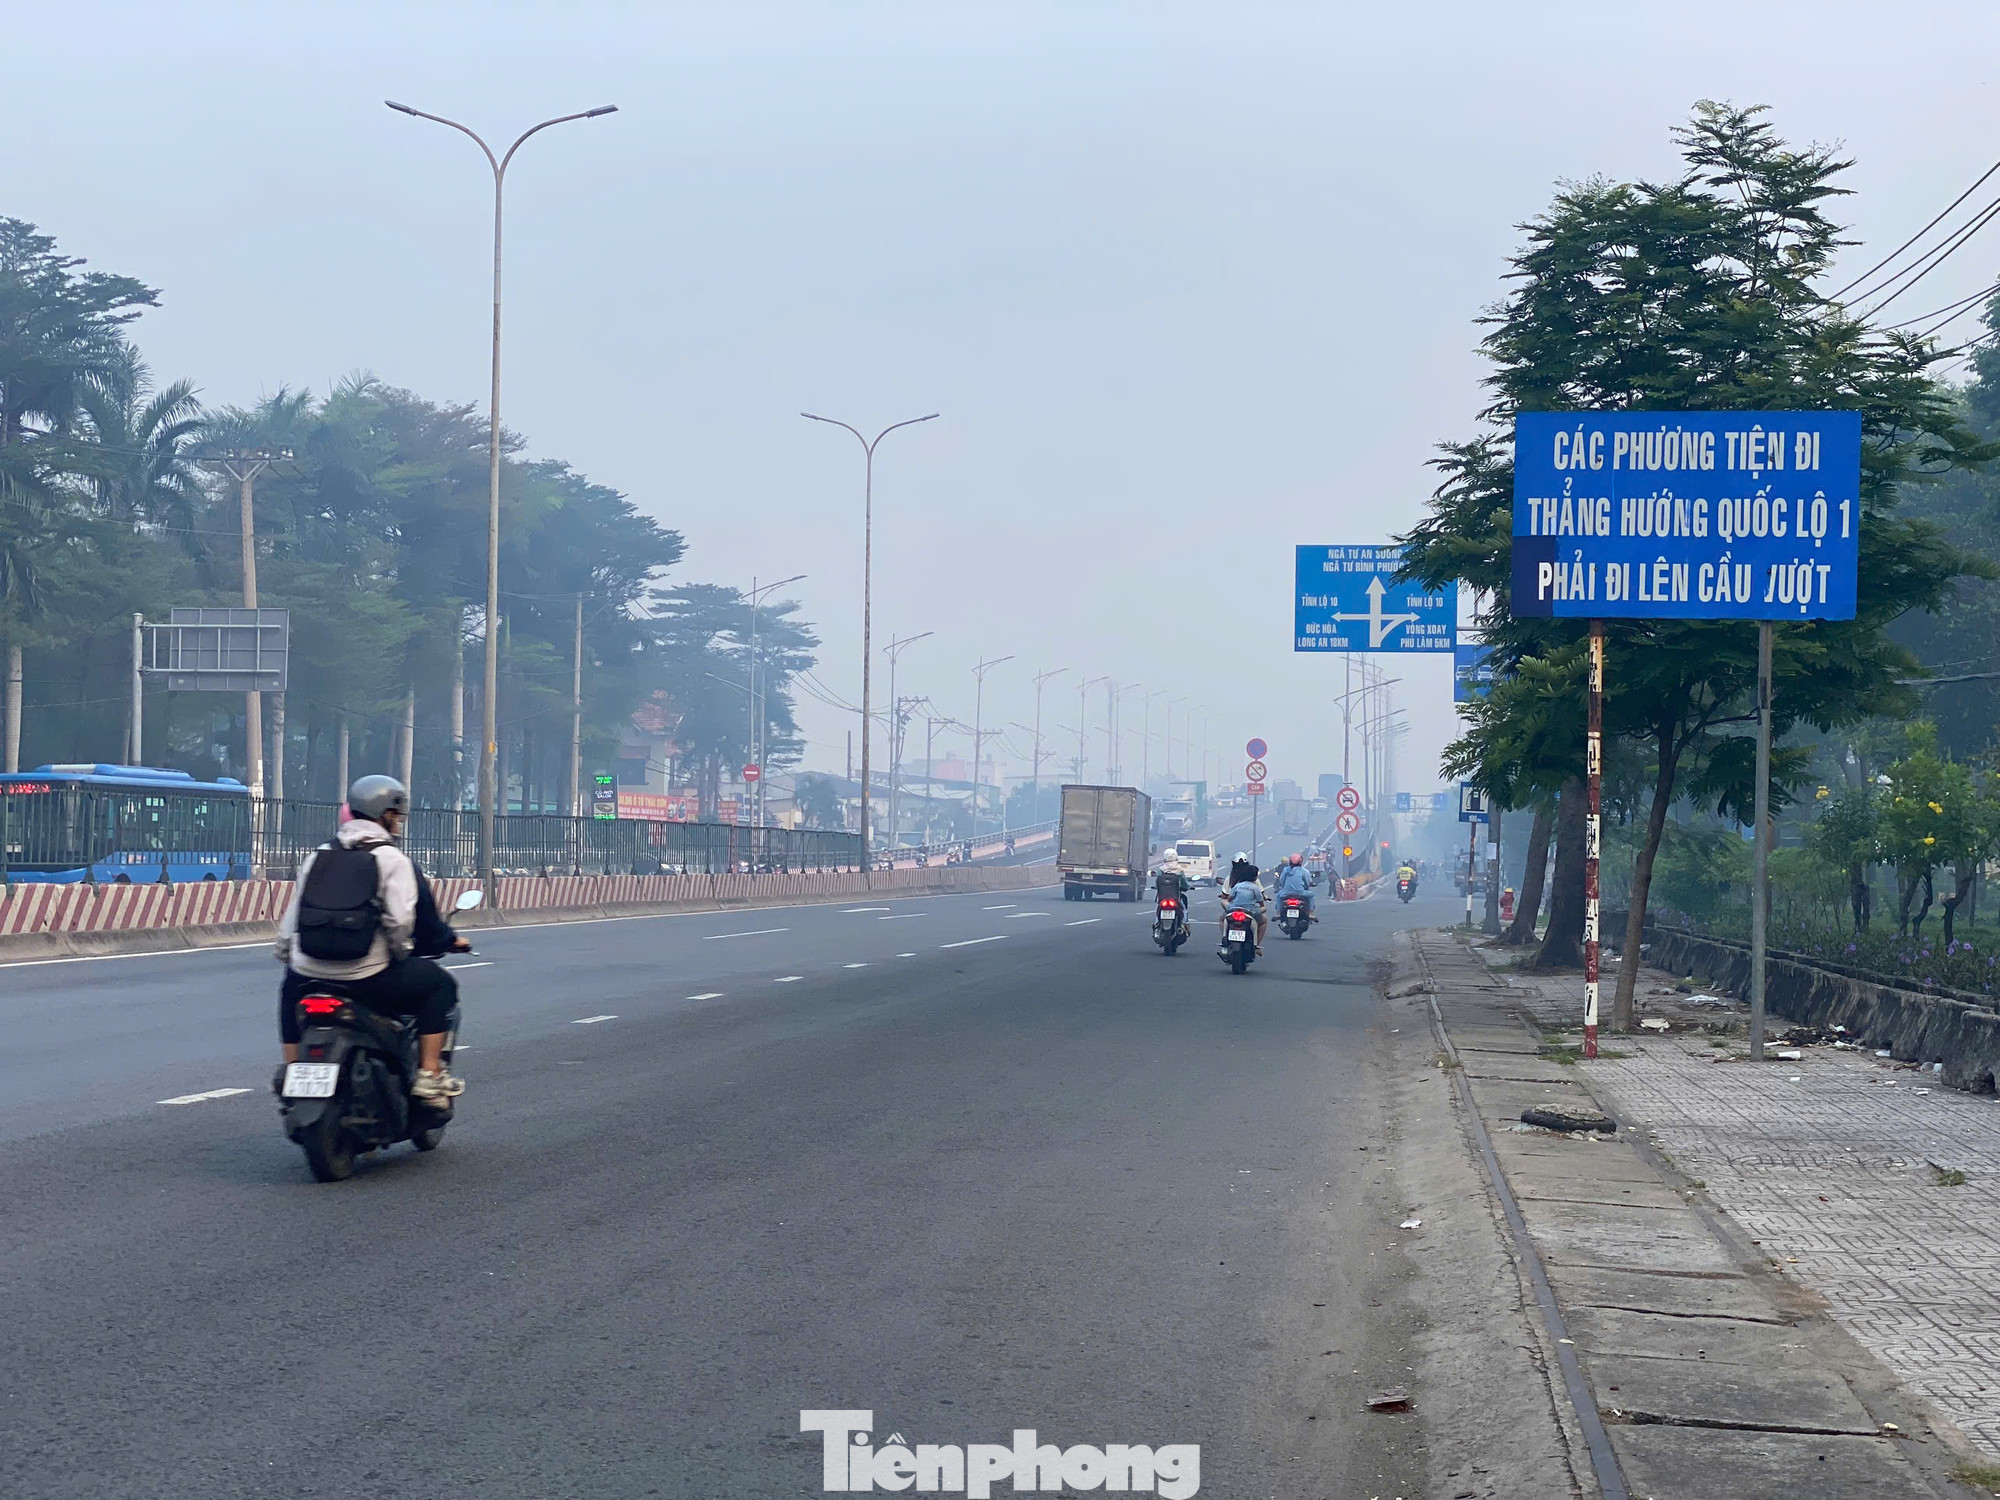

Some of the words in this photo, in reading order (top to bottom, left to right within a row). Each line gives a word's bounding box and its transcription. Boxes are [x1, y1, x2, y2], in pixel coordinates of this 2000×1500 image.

[1553, 423, 1605, 470] CÁC
[1613, 425, 1716, 471] PHƯƠNG
[1724, 424, 1785, 480] TIỆN
[1794, 431, 1820, 470] ĐI
[1527, 476, 1611, 537] THẲNG
[1620, 488, 1708, 538] HƯỚNG
[1717, 484, 1788, 544] QUỐC
[1796, 490, 1828, 548] LỘ
[1839, 499, 1851, 538] 1
[1328, 547, 1345, 559] NGÃ
[1348, 548, 1360, 559] TƯ
[1361, 549, 1373, 559] AN
[1323, 560, 1340, 572] NGÃ
[1342, 560, 1355, 572] TƯ
[1355, 560, 1374, 572] BÌNH
[1538, 549, 1597, 601] PHẢI
[1605, 562, 1631, 601] ĐI
[1638, 555, 1690, 602] LÊN
[1698, 551, 1752, 603] CẦU
[1318, 594, 1328, 610] LỘ
[1330, 596, 1338, 607] 10
[1423, 595, 1433, 610] LỘ
[1435, 597, 1444, 608] 10
[1305, 621, 1321, 634] ĐỨC
[1405, 621, 1425, 635] VÒNG
[1426, 624, 1447, 635] XOAY
[1297, 637, 1317, 648] LONG
[1317, 637, 1328, 648] AN
[1434, 637, 1450, 648] 5KM
